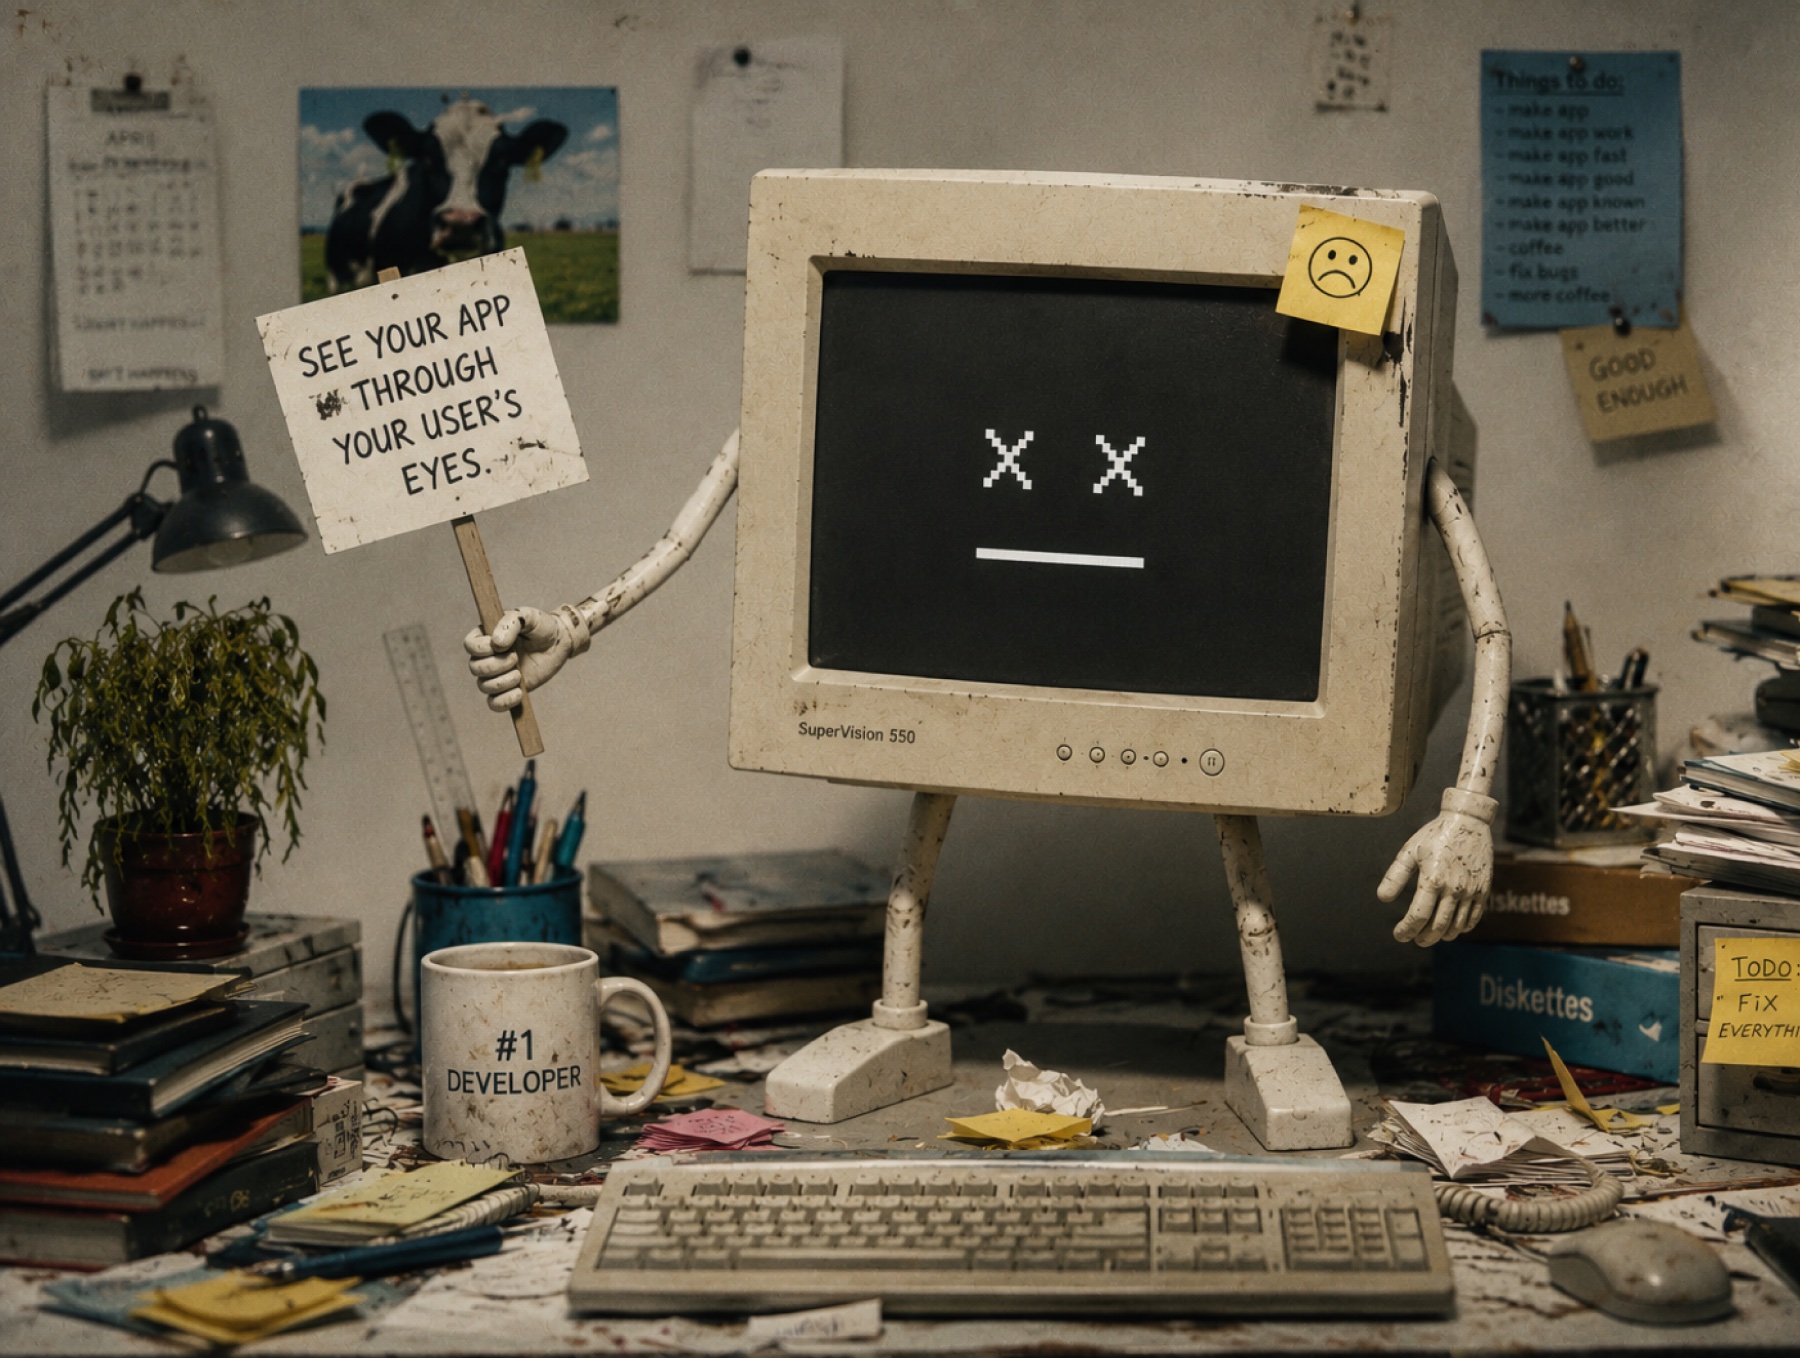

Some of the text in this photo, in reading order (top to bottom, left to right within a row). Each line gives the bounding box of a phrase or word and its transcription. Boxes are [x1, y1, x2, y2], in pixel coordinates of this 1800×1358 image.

[1497, 72, 1560, 94] Things
[1567, 73, 1588, 91] to
[1508, 103, 1589, 121] make app
[1508, 125, 1634, 144] make app work
[1508, 148, 1627, 166] make app fast
[1508, 170, 1634, 190] make app good
[1508, 193, 1645, 211] make app known
[1508, 216, 1646, 236] make app better
[1508, 240, 1563, 255] coffee
[1508, 263, 1579, 282] fix bugs
[1508, 286, 1611, 302] more coffee
[298, 294, 511, 378] SEE YOUR APP
[1588, 349, 1657, 382] GOOD
[351, 346, 498, 411] THROUGH
[1597, 374, 1690, 414] ENOUGH
[332, 388, 523, 465] YOUR USER'S
[401, 447, 492, 496] EYES.
[798, 721, 916, 744] SuperVision 550
[1484, 889, 1571, 916] iskettes
[1480, 972, 1594, 1023] Diskettes
[495, 1029, 533, 1062] #1
[447, 1065, 581, 1095] DEVELOPER
